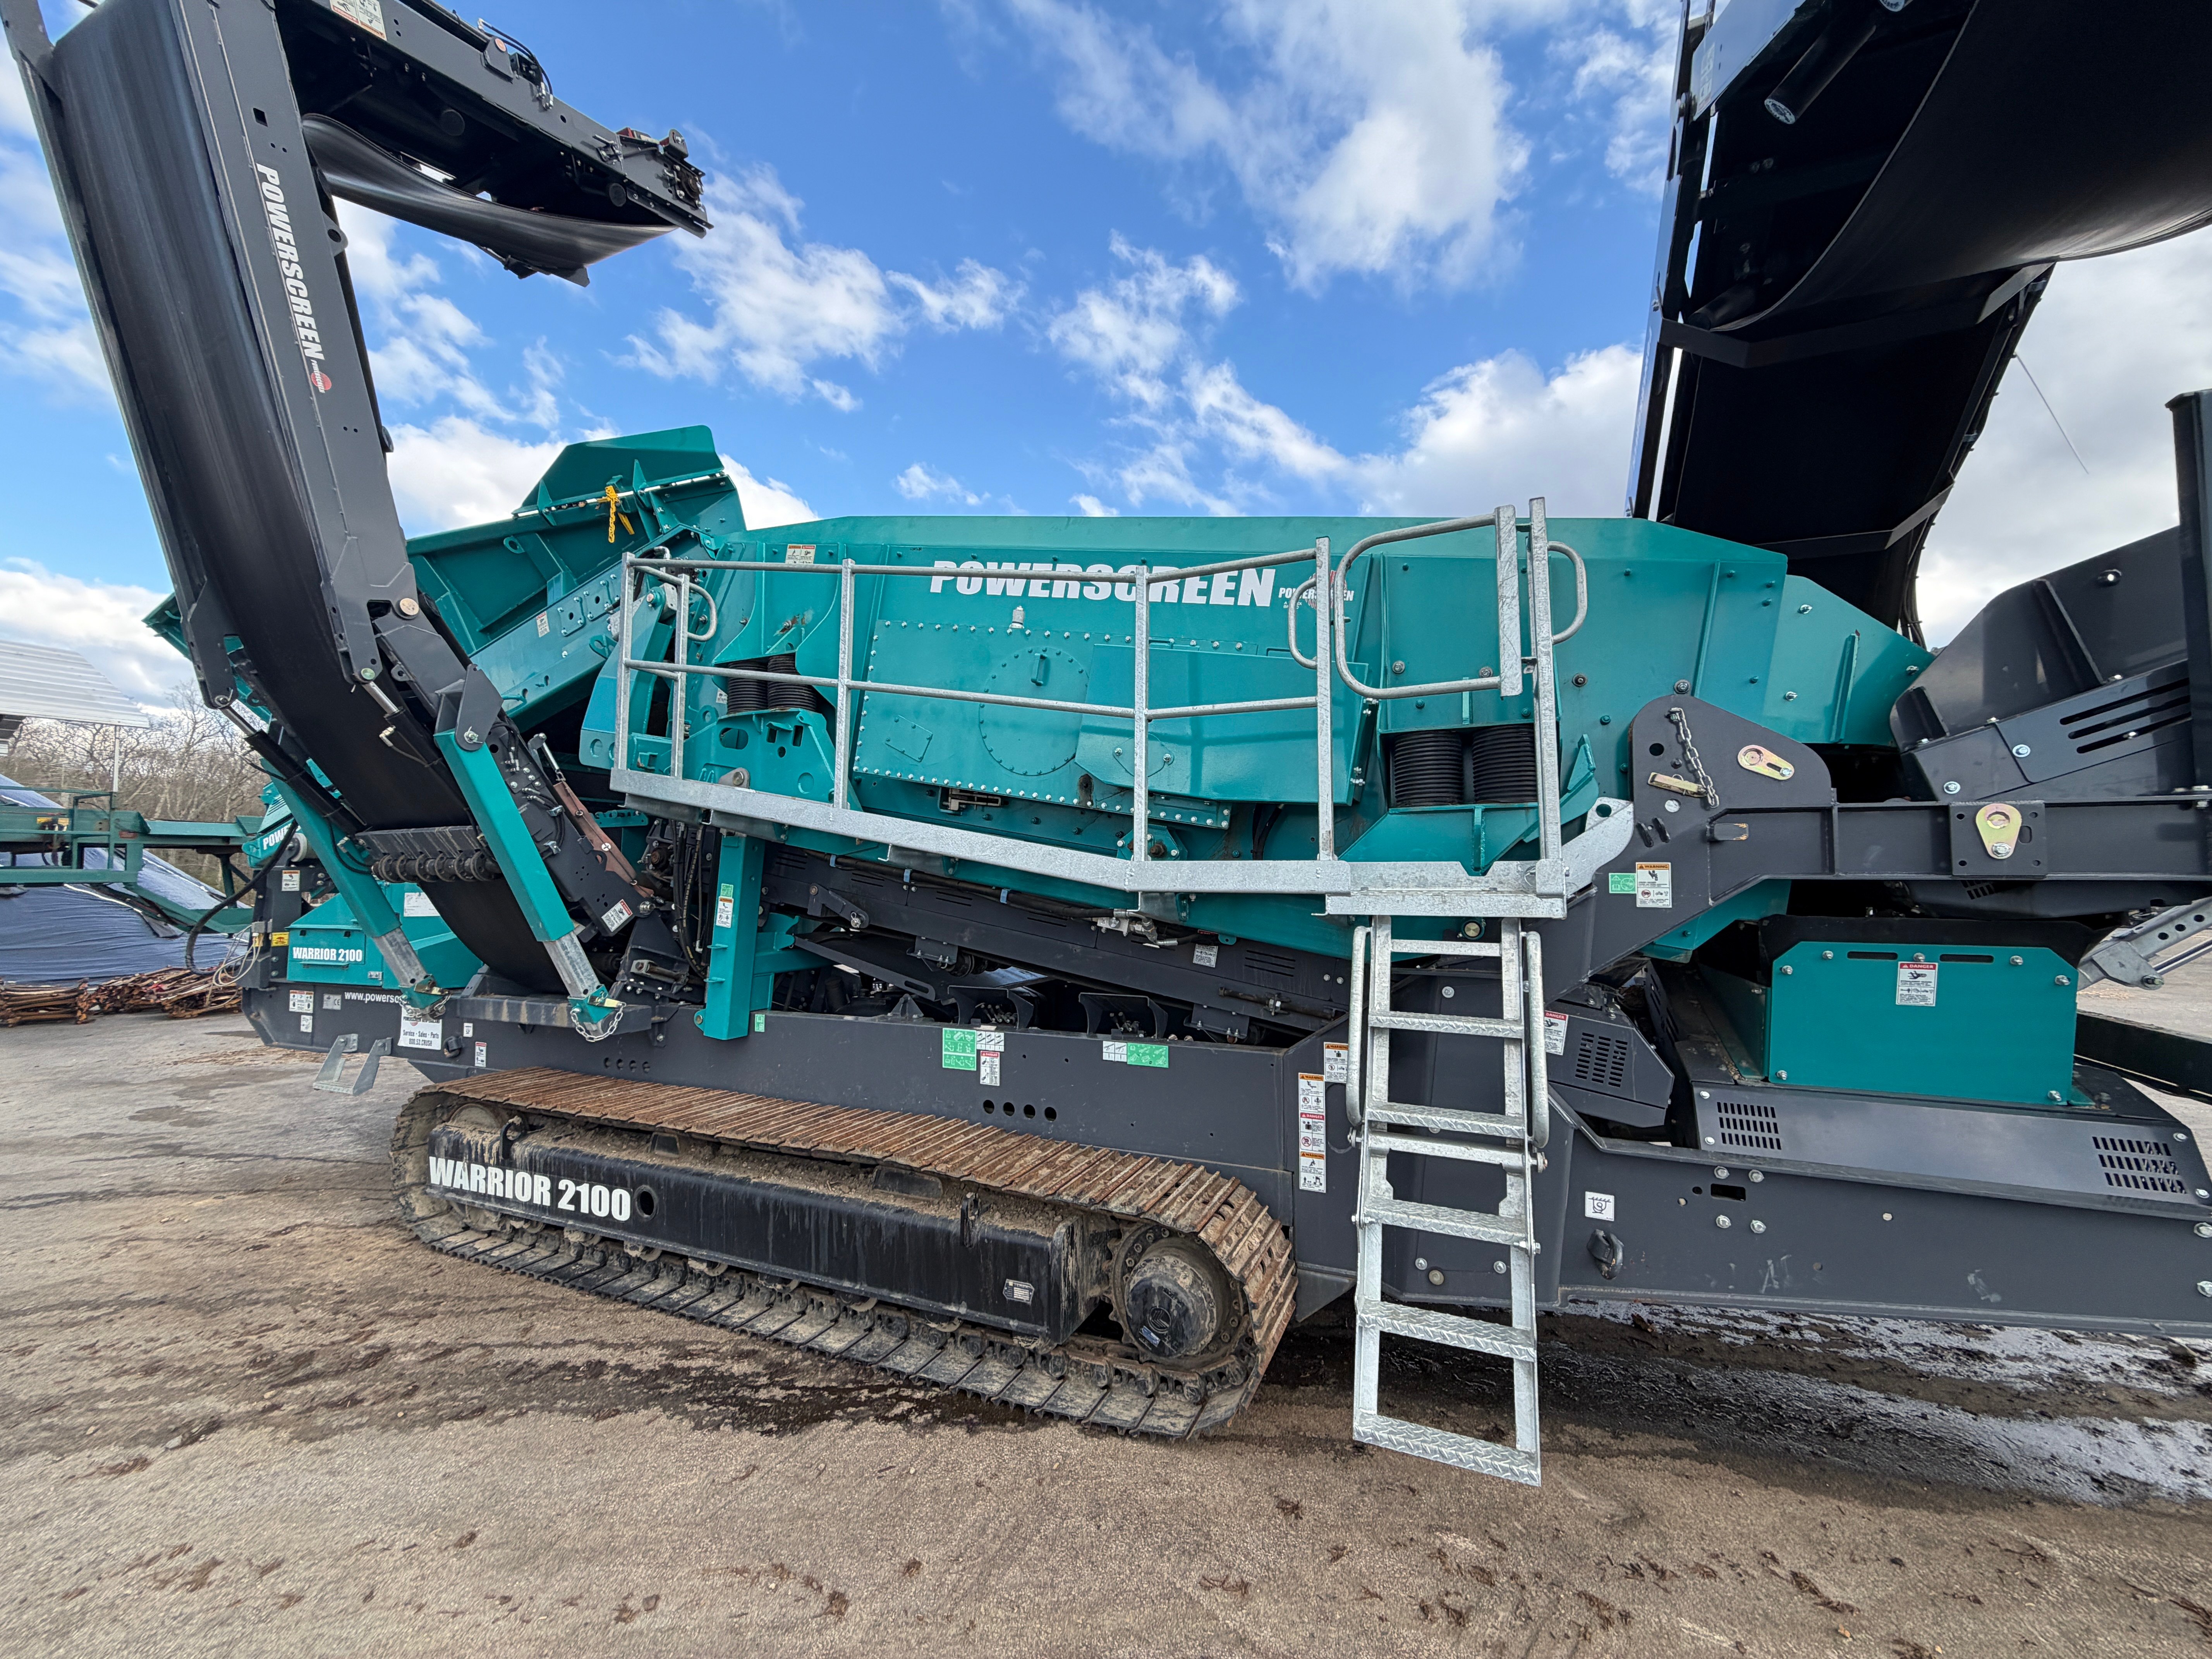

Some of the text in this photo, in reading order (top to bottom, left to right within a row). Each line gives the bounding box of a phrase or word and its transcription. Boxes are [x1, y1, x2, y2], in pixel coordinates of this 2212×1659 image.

[256, 163, 325, 361] POWERSCREEN
[293, 947, 362, 962] WARRIOR 2100
[429, 1156, 630, 1221] WARRIOR 2100
